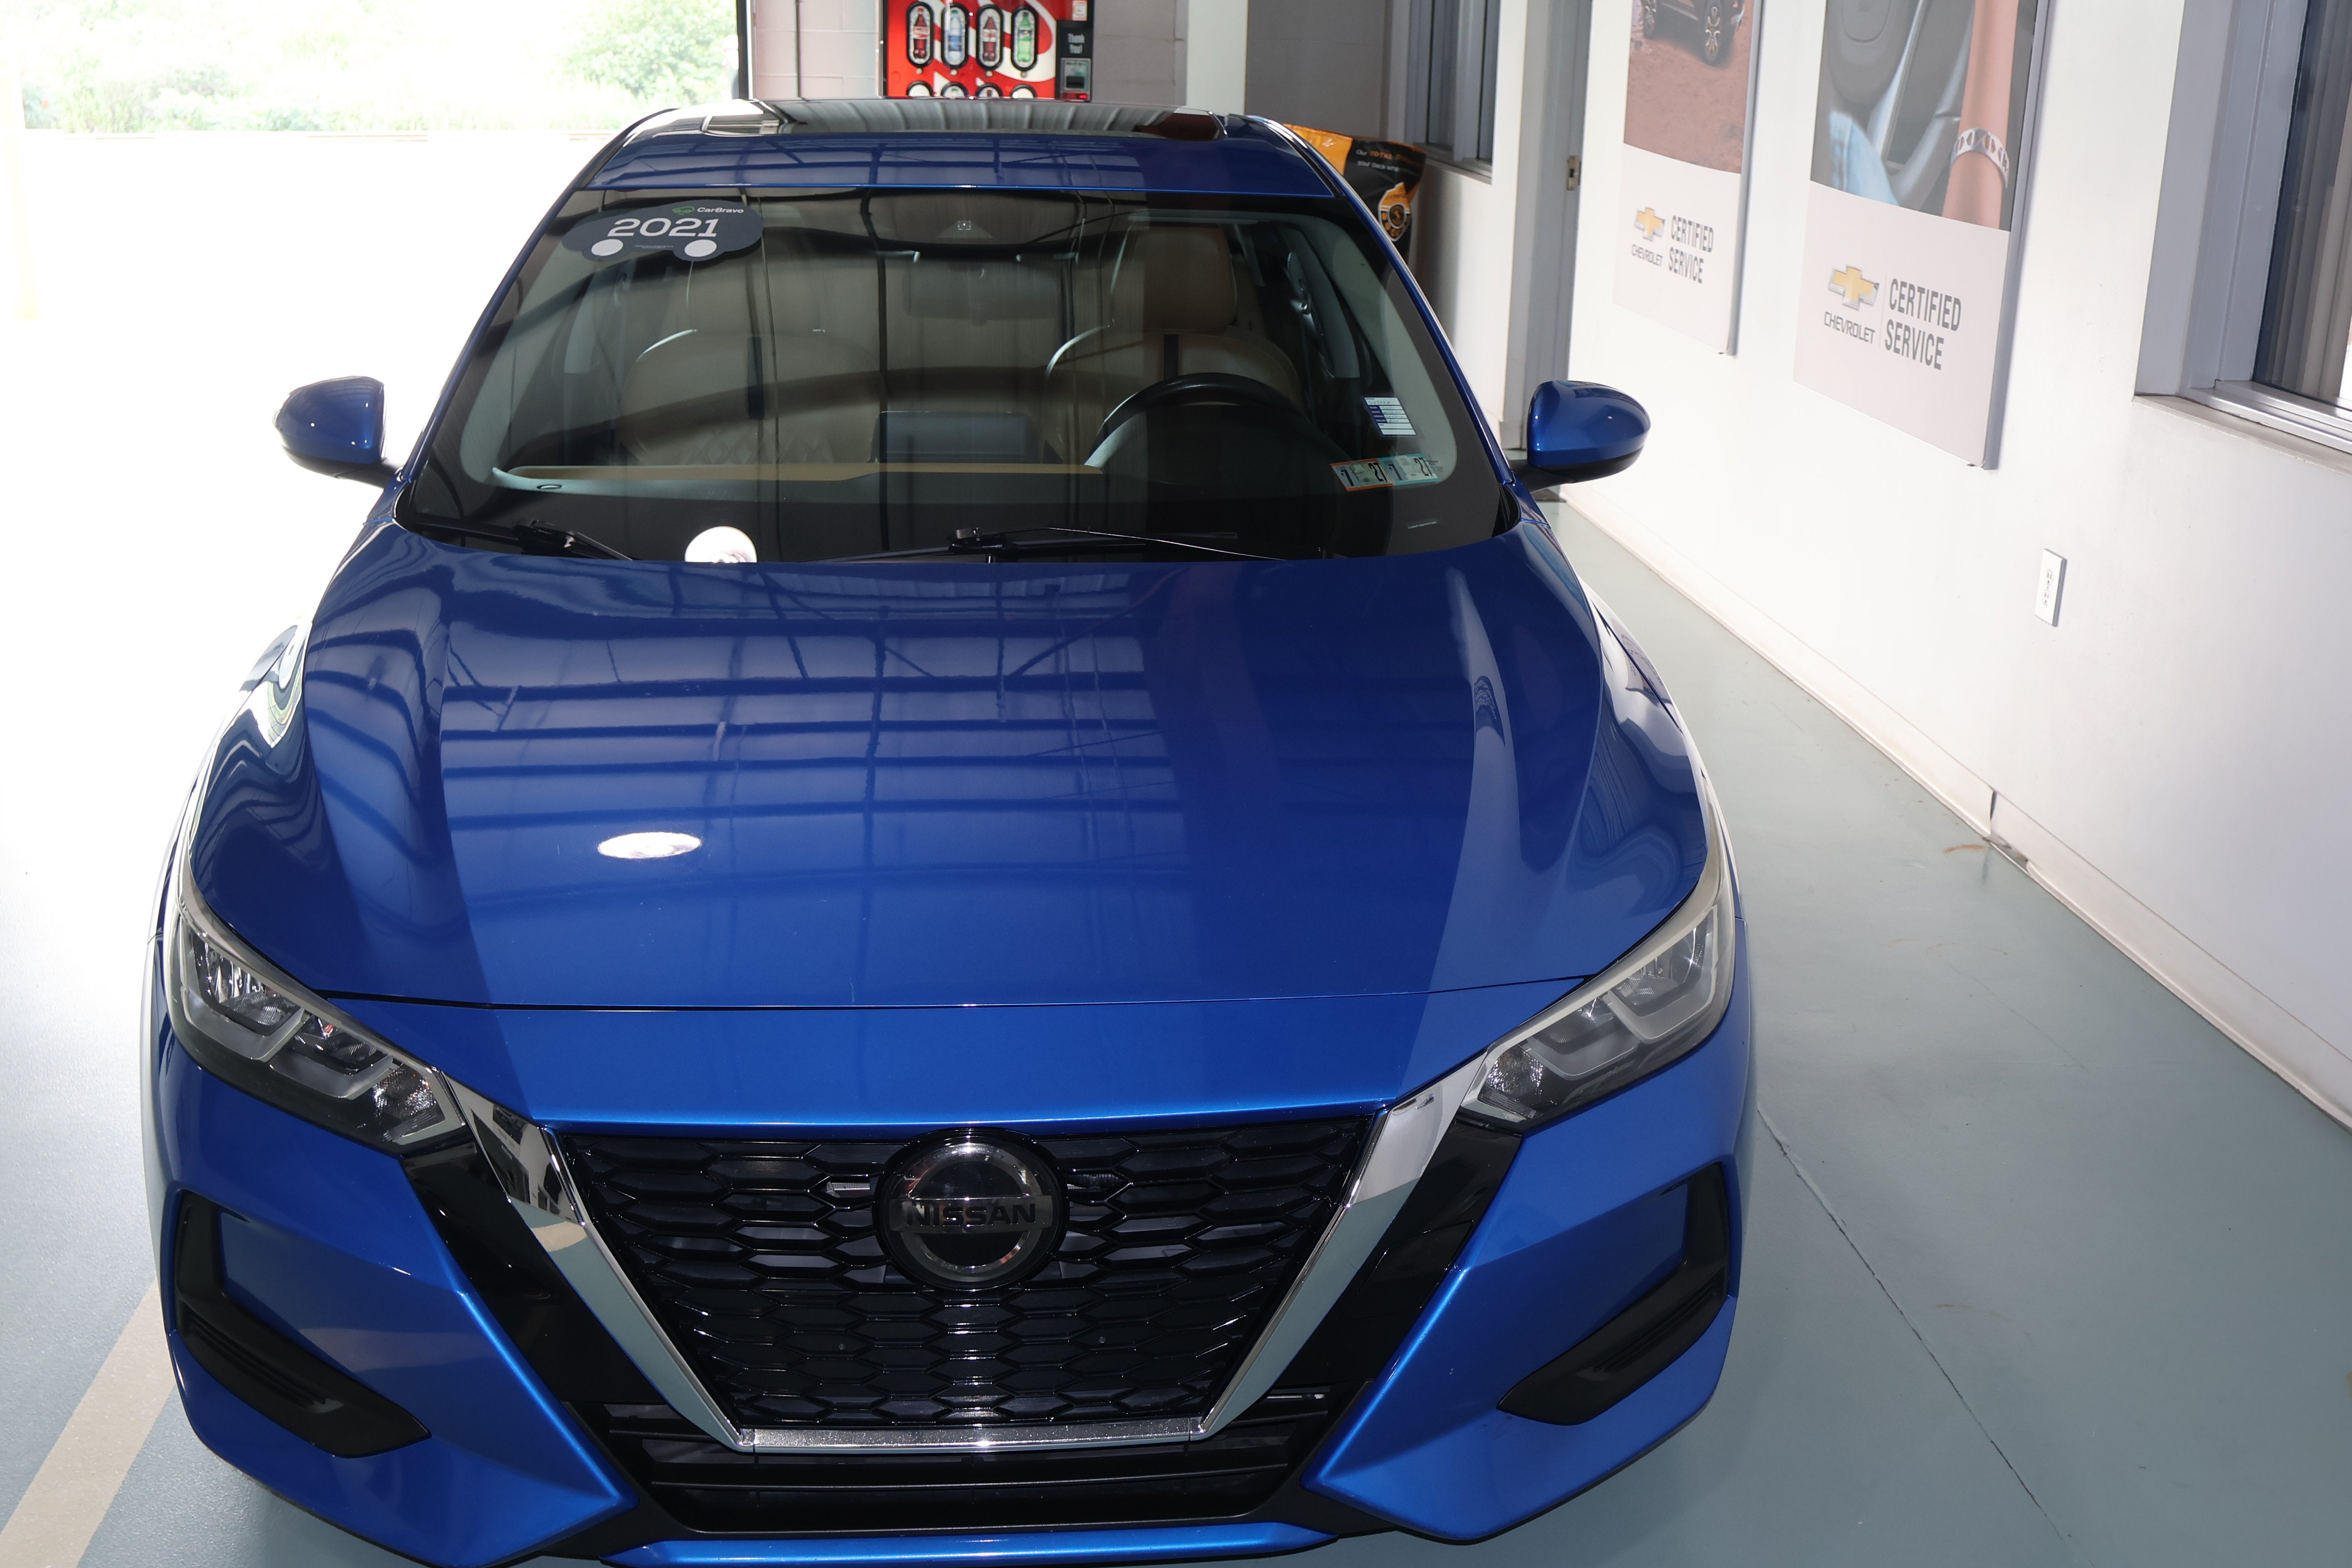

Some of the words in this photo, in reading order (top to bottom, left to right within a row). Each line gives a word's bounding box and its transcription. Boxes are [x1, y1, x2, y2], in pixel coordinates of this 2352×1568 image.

[607, 218, 719, 237] 2021
[1670, 215, 1714, 253] CERTIFIED
[1631, 244, 1663, 267] CHEVROLET
[1668, 247, 1704, 283] SERVICE
[1889, 278, 1962, 331] CERTIFIED
[1824, 312, 1875, 344] CHEVROLET
[1885, 319, 1944, 370] SERVICE
[1368, 462, 1388, 483] 27
[1414, 457, 1433, 477] 27
[907, 1204, 1036, 1225] NISSAN
